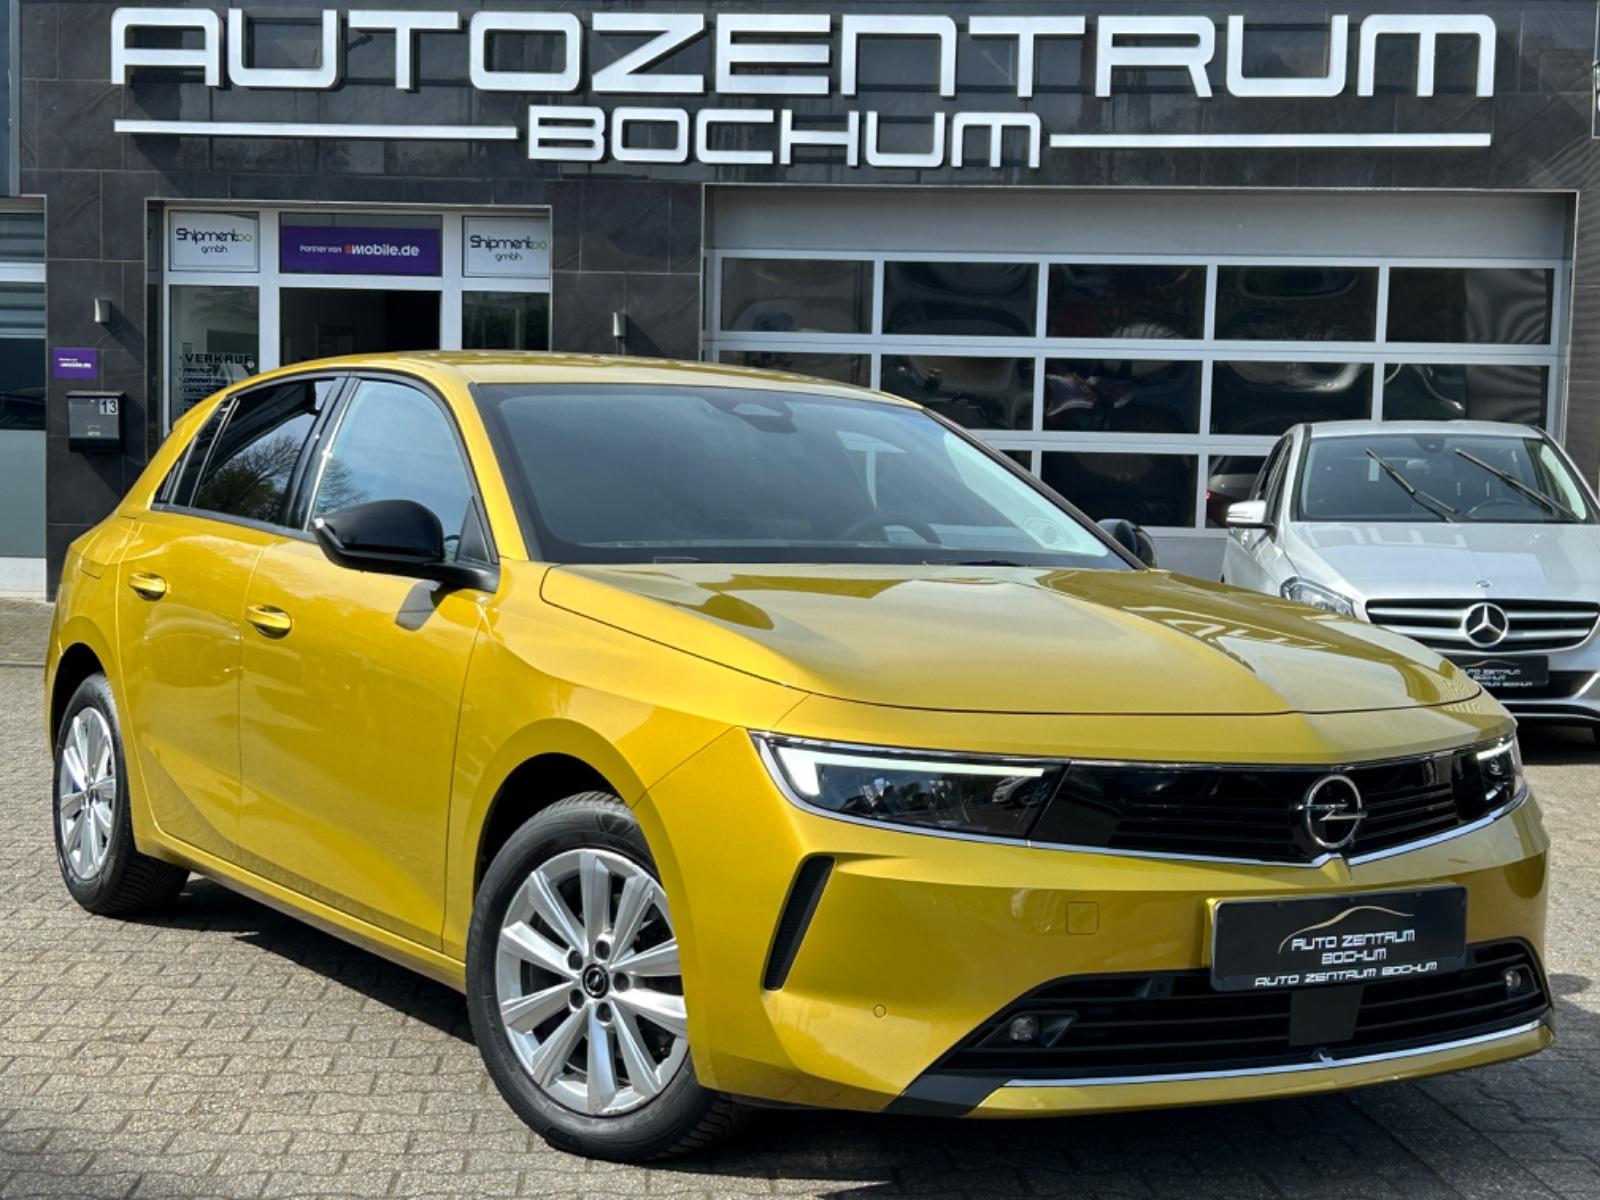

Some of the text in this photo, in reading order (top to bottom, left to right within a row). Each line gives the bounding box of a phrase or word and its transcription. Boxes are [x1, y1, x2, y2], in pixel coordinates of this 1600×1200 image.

[110, 7, 1497, 98] AUTOZENTRUM
[527, 104, 1042, 169] BOCHUM
[300, 244, 326, 253] Partner
[351, 243, 420, 257] mobile.de
[184, 353, 254, 364] VERKAUF
[101, 399, 117, 414] 13
[1291, 929, 1416, 951] AUTO ZENTRUM
[1321, 947, 1388, 966] BOCHUM
[1254, 960, 1438, 988] AUTO ZENTRUM BOCHUM
